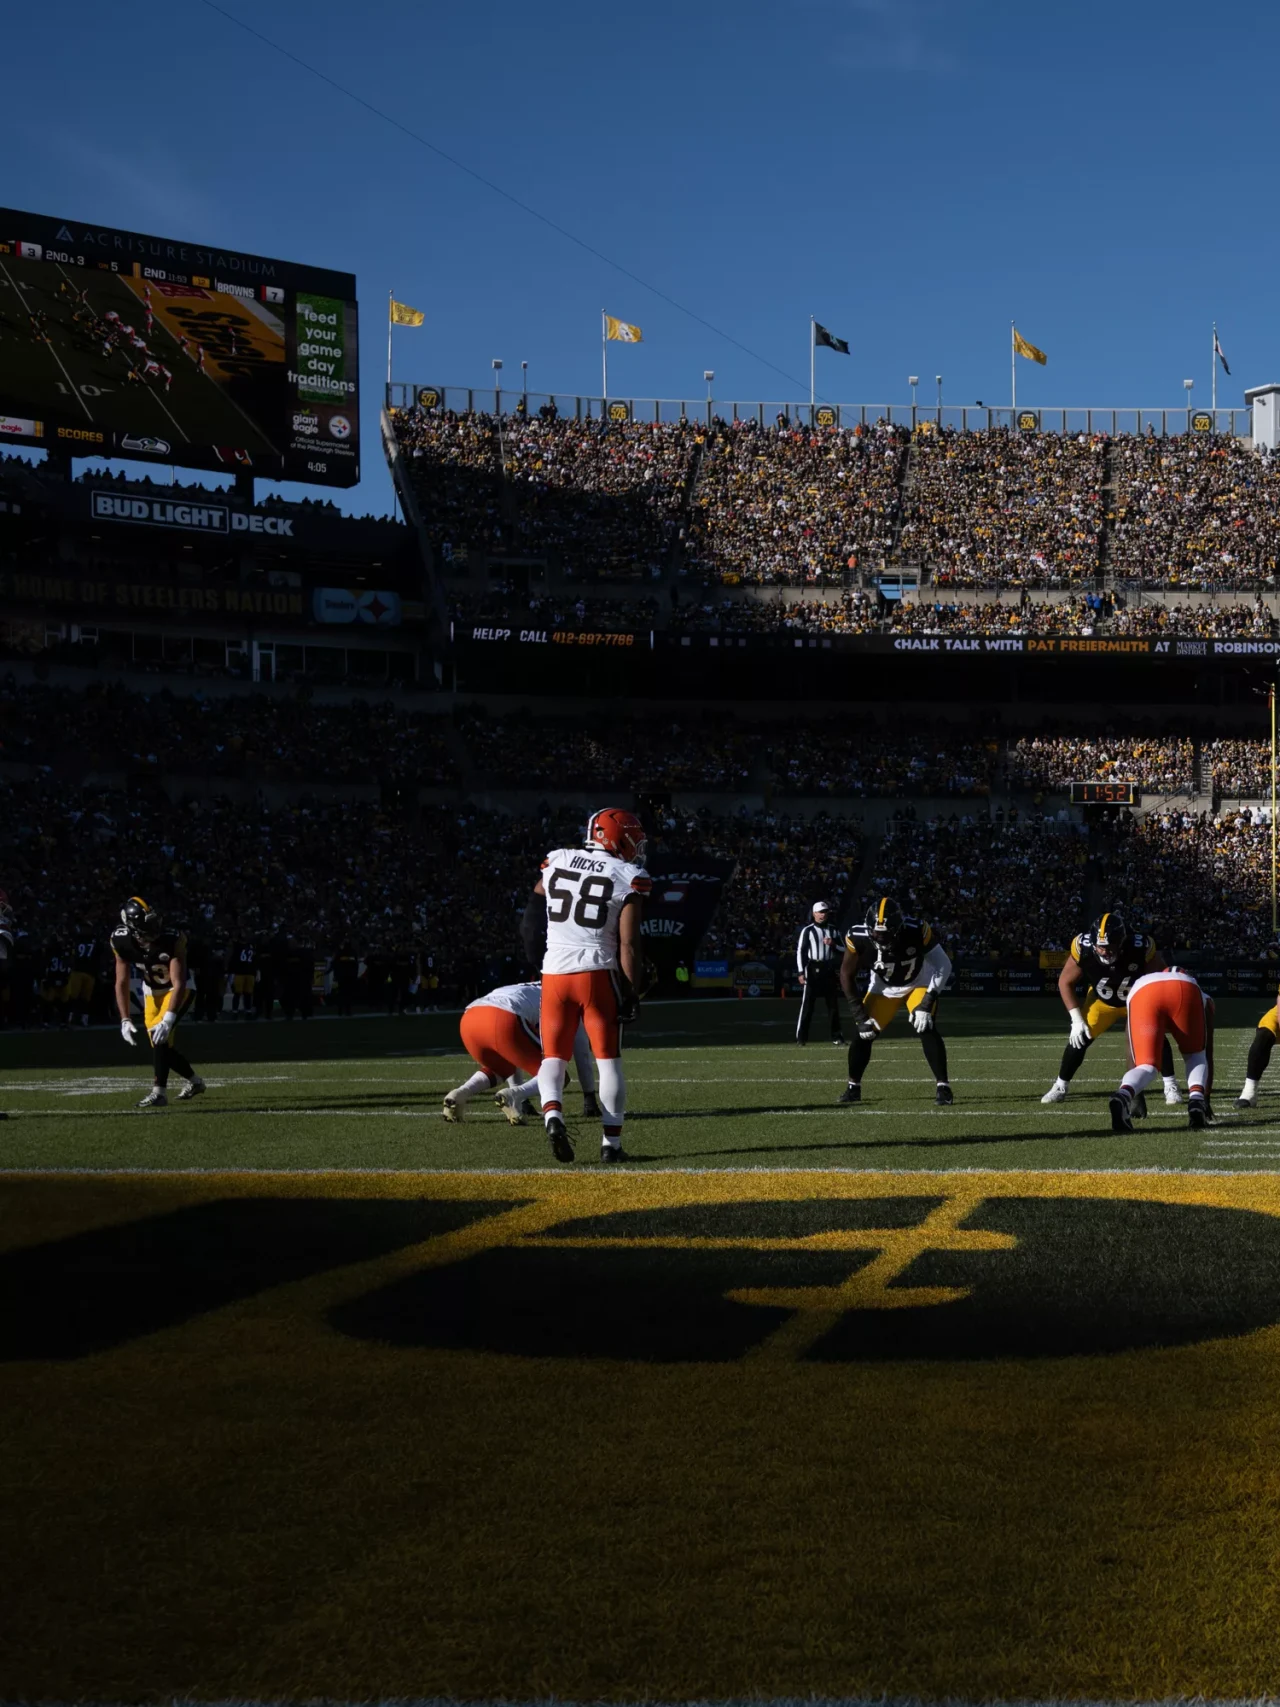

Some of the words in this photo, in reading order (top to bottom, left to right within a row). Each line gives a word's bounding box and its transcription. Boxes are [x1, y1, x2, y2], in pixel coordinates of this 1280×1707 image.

[27, 248, 36, 257] 3
[84, 232, 189, 261] ACRISURE
[195, 251, 277, 277] STADIUM
[45, 250, 68, 263] 2ND
[76, 256, 85, 266] 3
[110, 262, 119, 272] 5
[143, 267, 167, 280] 2ND
[217, 282, 255, 298] BROWNS
[271, 291, 278, 300] 7
[304, 309, 337, 326] feed
[305, 327, 337, 341] your
[300, 342, 342, 358] game
[307, 358, 335, 376] day
[287, 369, 356, 393] traditions
[420, 393, 437, 405] 527
[292, 413, 319, 426] giant
[611, 406, 627, 419] 526
[817, 411, 834, 423] 525
[1, 424, 23, 433] eagle
[292, 424, 319, 435] eagle
[1193, 418, 1210, 431] 523
[57, 427, 104, 443] SCORES
[307, 461, 327, 473] 4:05
[97, 496, 150, 518] BUD
[153, 503, 224, 528] LIGHT
[232, 512, 295, 536] DECK
[81, 580, 109, 604] OF
[225, 589, 303, 616] NATION
[472, 627, 511, 642] HELP?
[519, 630, 548, 643] CALL
[894, 639, 940, 651] CHALK
[944, 639, 981, 651] TALK
[984, 640, 1024, 651] WITH
[1027, 640, 1055, 651] PAT
[1060, 640, 1149, 652] FREIERMUTH
[1154, 641, 1171, 653] AT
[1176, 642, 1208, 650] MARKET
[1083, 784, 1127, 802] 11:52
[569, 855, 606, 873] HICKS
[547, 868, 614, 929] 58
[639, 918, 686, 936] HEINZ
[77, 943, 95, 958] 97
[240, 948, 254, 964] 62
[883, 956, 918, 982] 77
[1095, 976, 1131, 1001] 66
